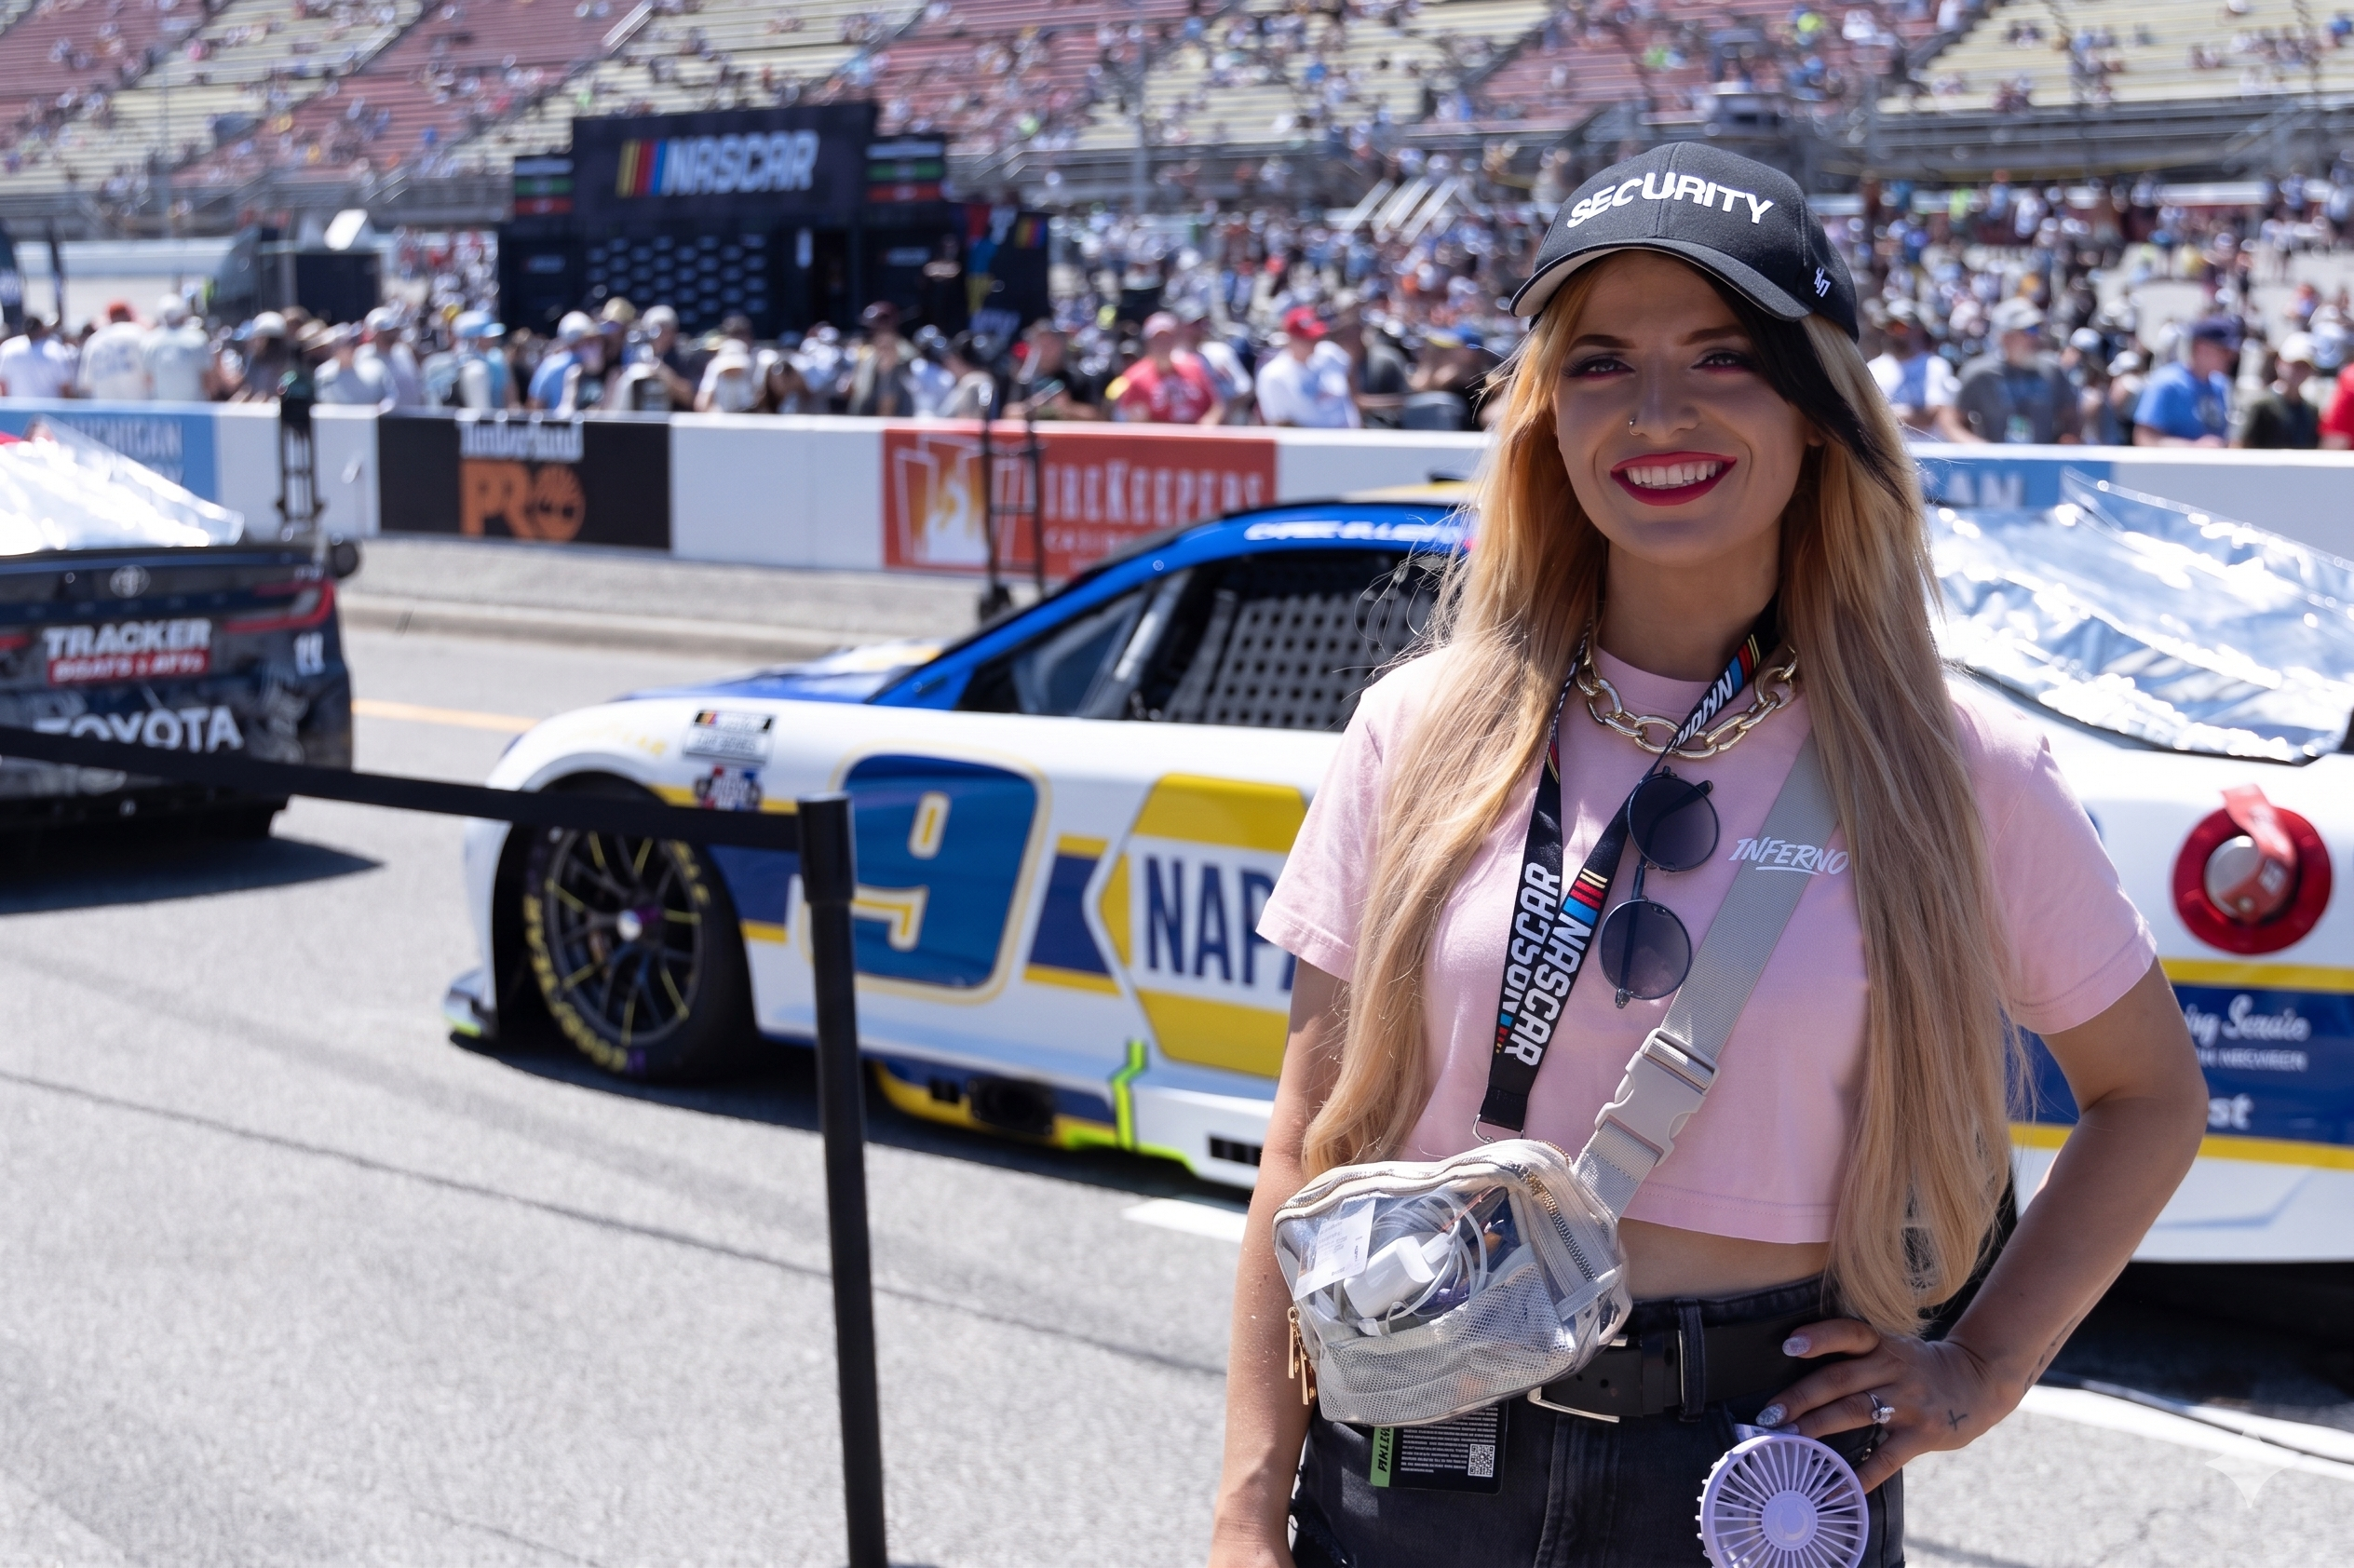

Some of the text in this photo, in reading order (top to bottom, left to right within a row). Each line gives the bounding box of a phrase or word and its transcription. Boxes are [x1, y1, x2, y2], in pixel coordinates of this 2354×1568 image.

[660, 129, 819, 196] NASCAR
[1567, 171, 1774, 228] SECURITY
[43, 618, 212, 657] TRACKER
[821, 750, 1043, 993] 9
[1728, 836, 1849, 875] INFERNO
[1144, 854, 1295, 993] NAP
[1504, 912, 1592, 1066] NASCAR
